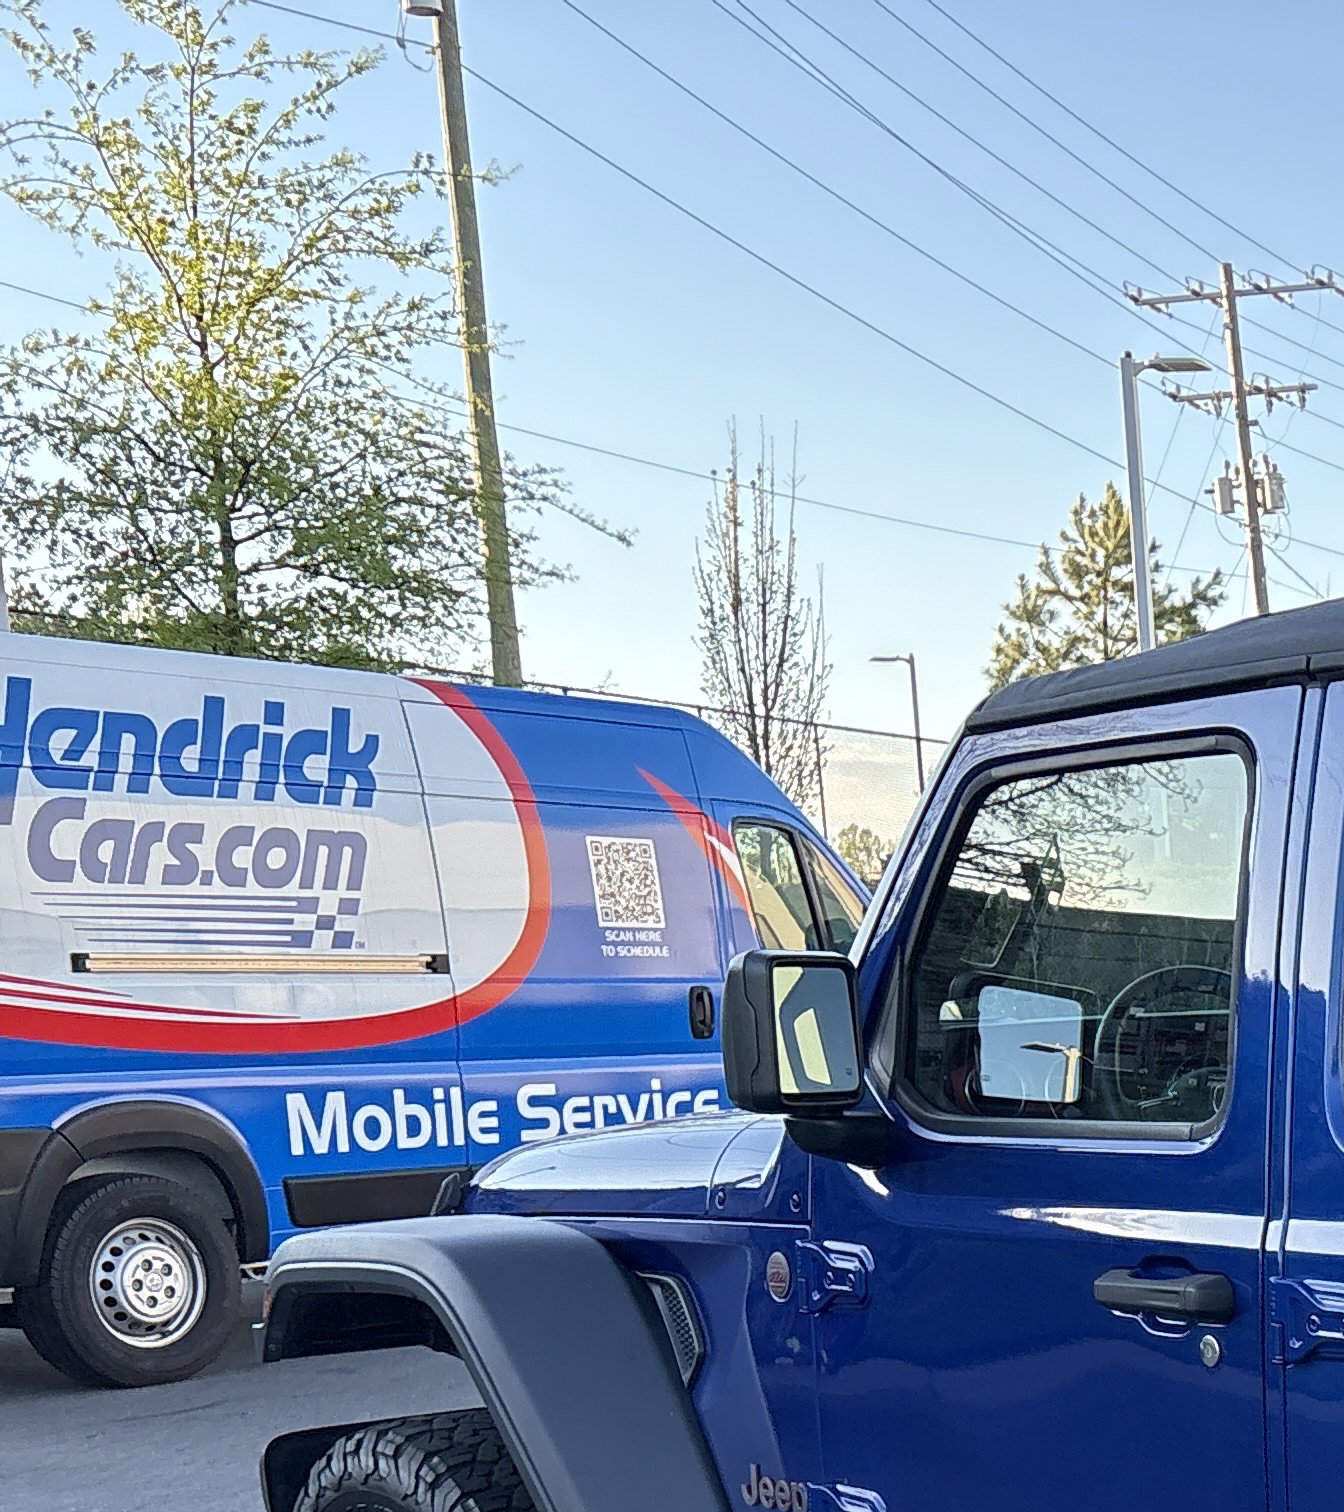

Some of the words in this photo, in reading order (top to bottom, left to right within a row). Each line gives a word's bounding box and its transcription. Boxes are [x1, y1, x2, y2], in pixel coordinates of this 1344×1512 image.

[27, 796, 368, 892] Cars.com
[600, 944, 616, 957] TO
[616, 945, 670, 957] SCHEDULE
[604, 929, 634, 942] SCAN
[635, 930, 663, 942] HERE
[285, 1086, 499, 1156] Mobile
